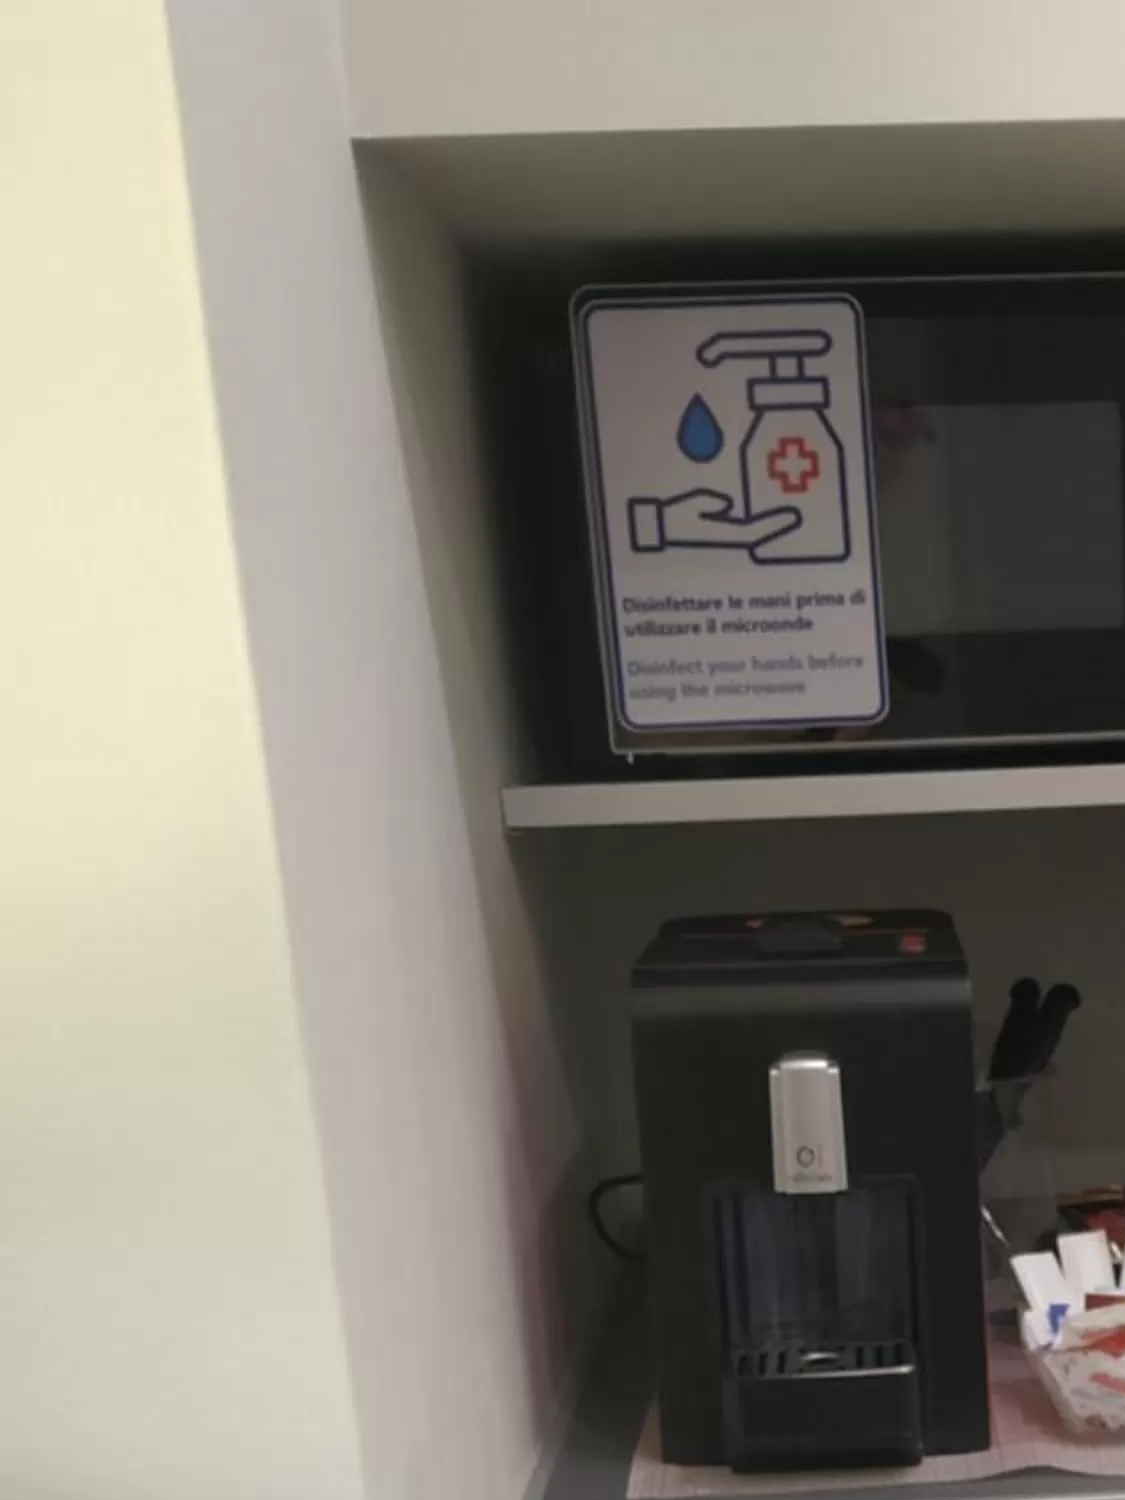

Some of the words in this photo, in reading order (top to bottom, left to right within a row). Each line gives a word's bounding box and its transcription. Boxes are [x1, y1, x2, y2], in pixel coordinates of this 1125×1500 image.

[623, 595, 723, 613] Disinfettare
[729, 593, 743, 611] le
[749, 592, 791, 610] mani
[797, 591, 845, 611] prima
[849, 588, 866, 606] di
[624, 618, 701, 637] utilizzare
[706, 617, 718, 634] il
[722, 616, 814, 634] microonde
[627, 656, 704, 676] Disinfect
[709, 658, 746, 675] your
[752, 654, 804, 672] hands
[808, 652, 863, 671] before
[681, 679, 709, 697] the
